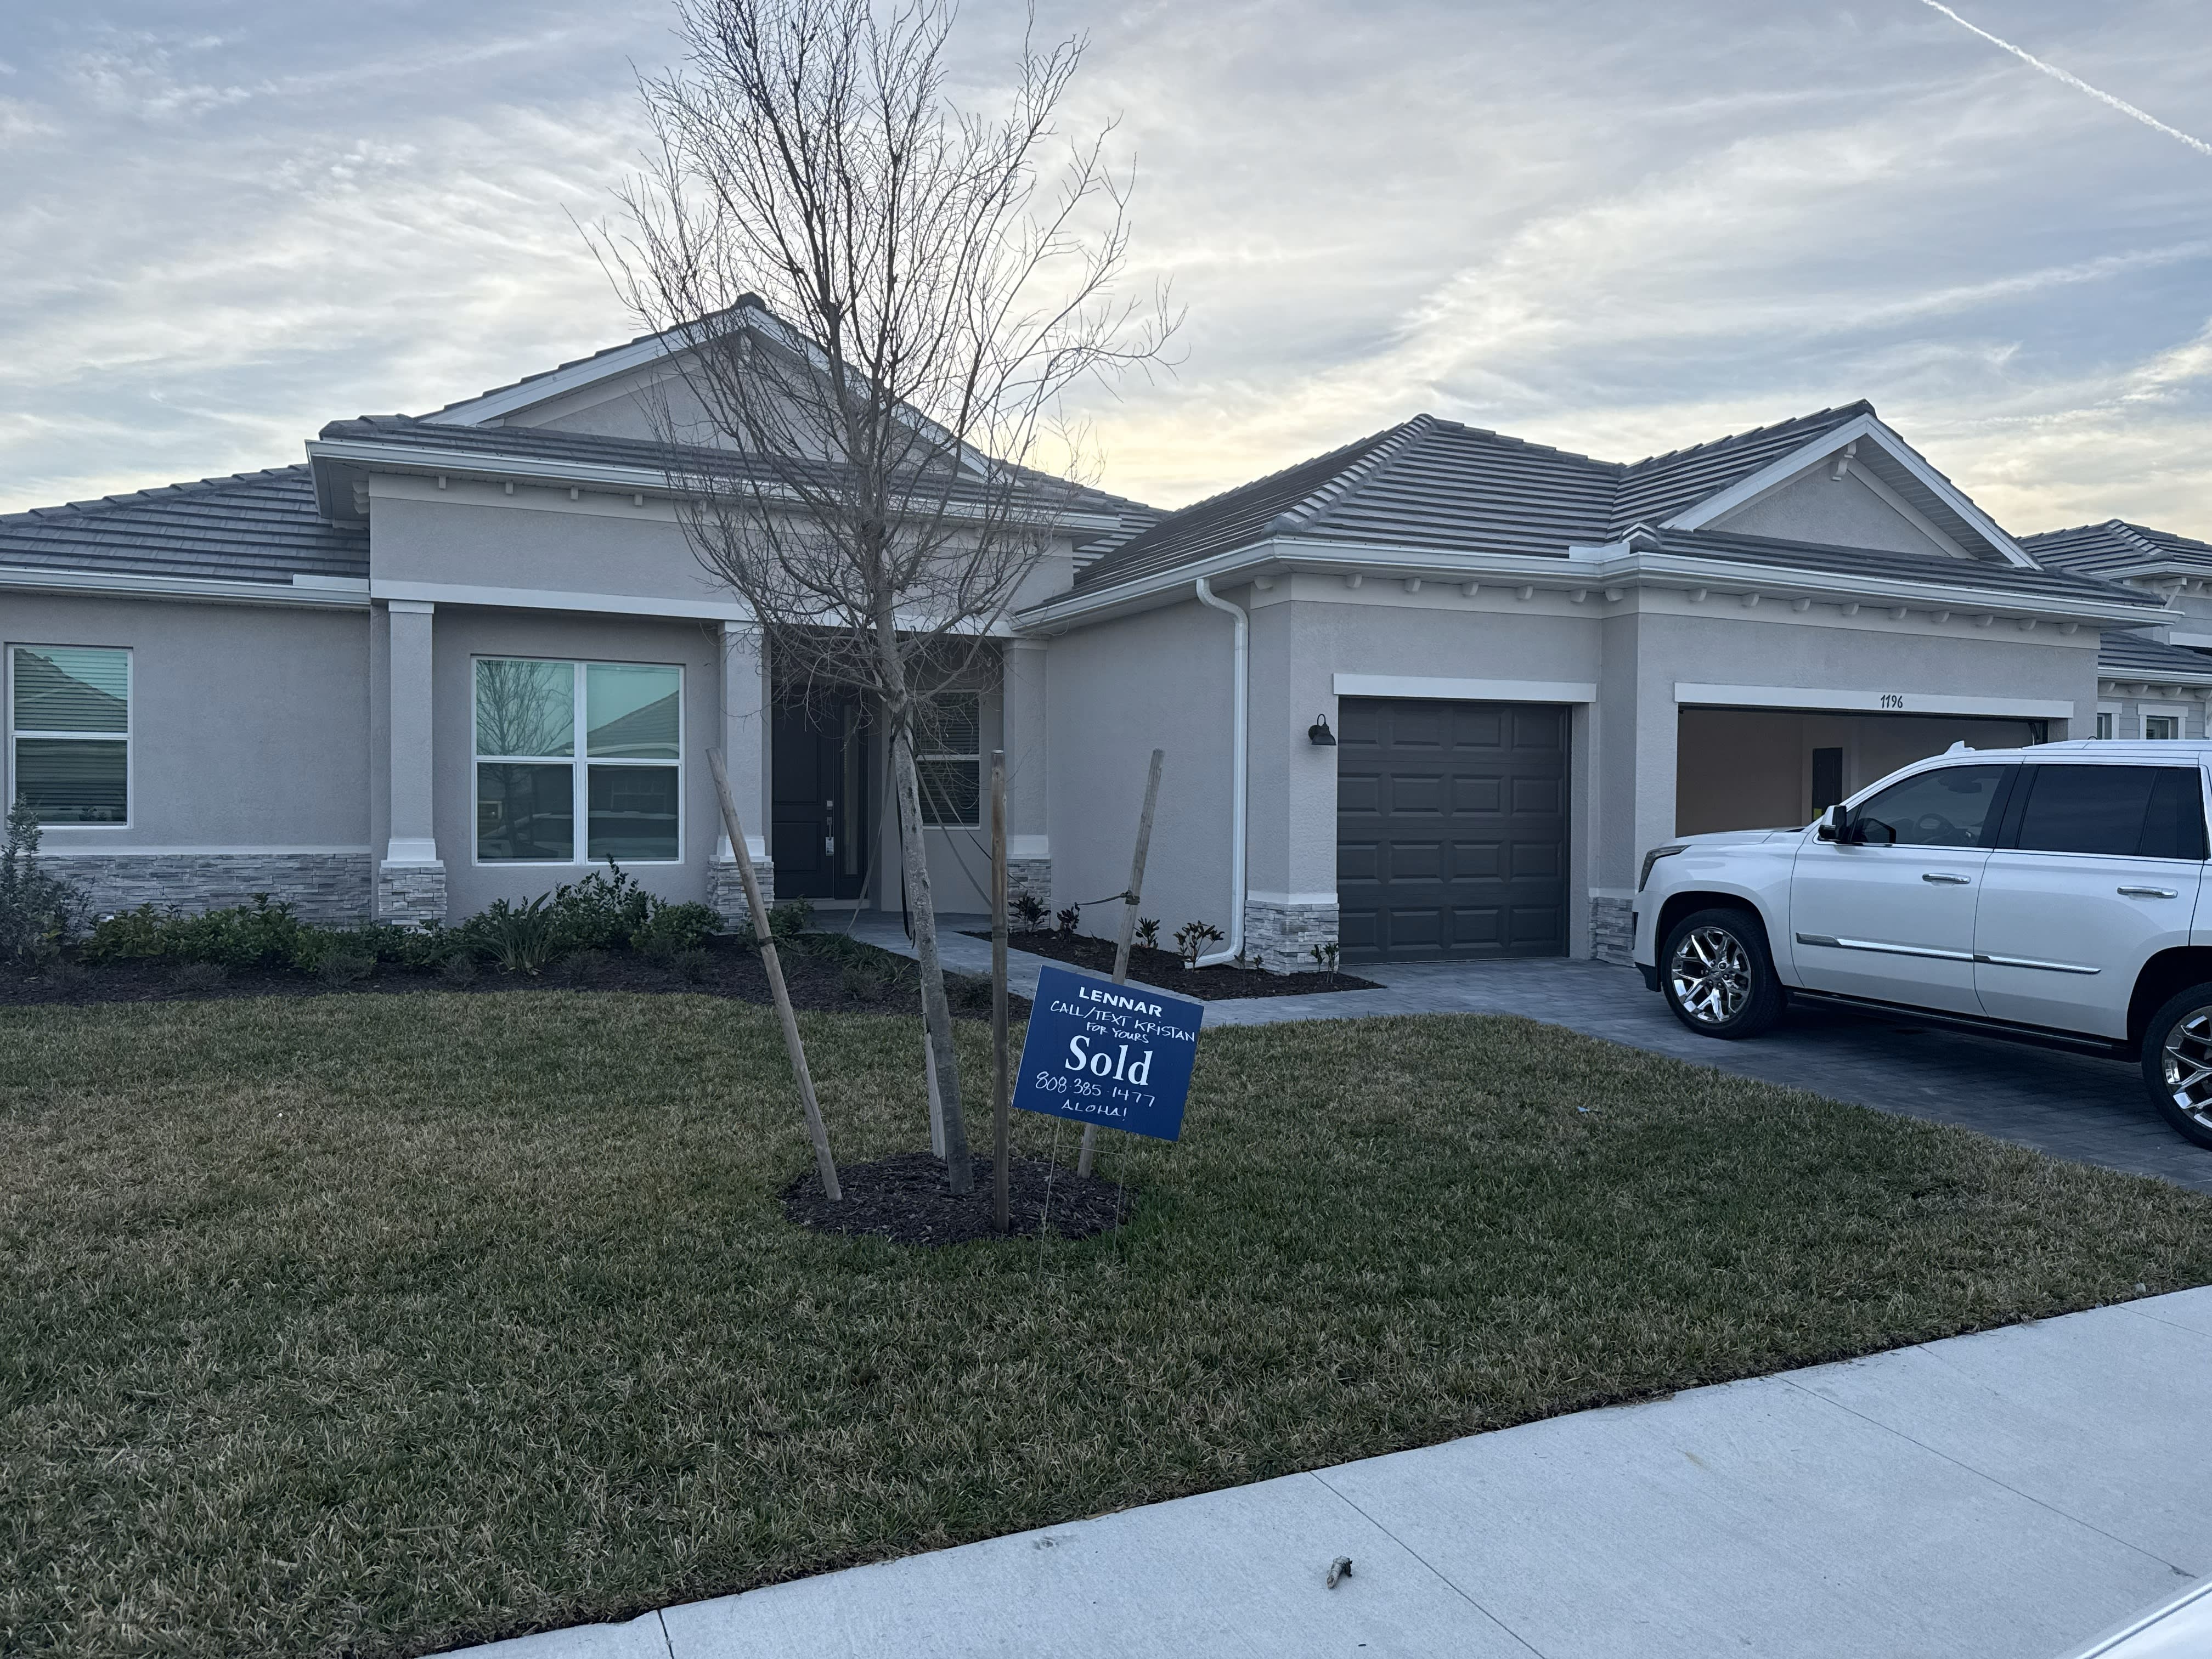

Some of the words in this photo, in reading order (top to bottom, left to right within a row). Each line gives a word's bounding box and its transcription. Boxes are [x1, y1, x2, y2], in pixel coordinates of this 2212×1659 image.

[1881, 694, 1903, 709] 1196
[1079, 986, 1162, 1017] LENNAR
[1086, 1022, 1108, 1035] FOR
[1112, 1028, 1149, 1043] YOURS
[1065, 1035, 1153, 1086] Sold
[1061, 1099, 1127, 1121] ALOHA!
